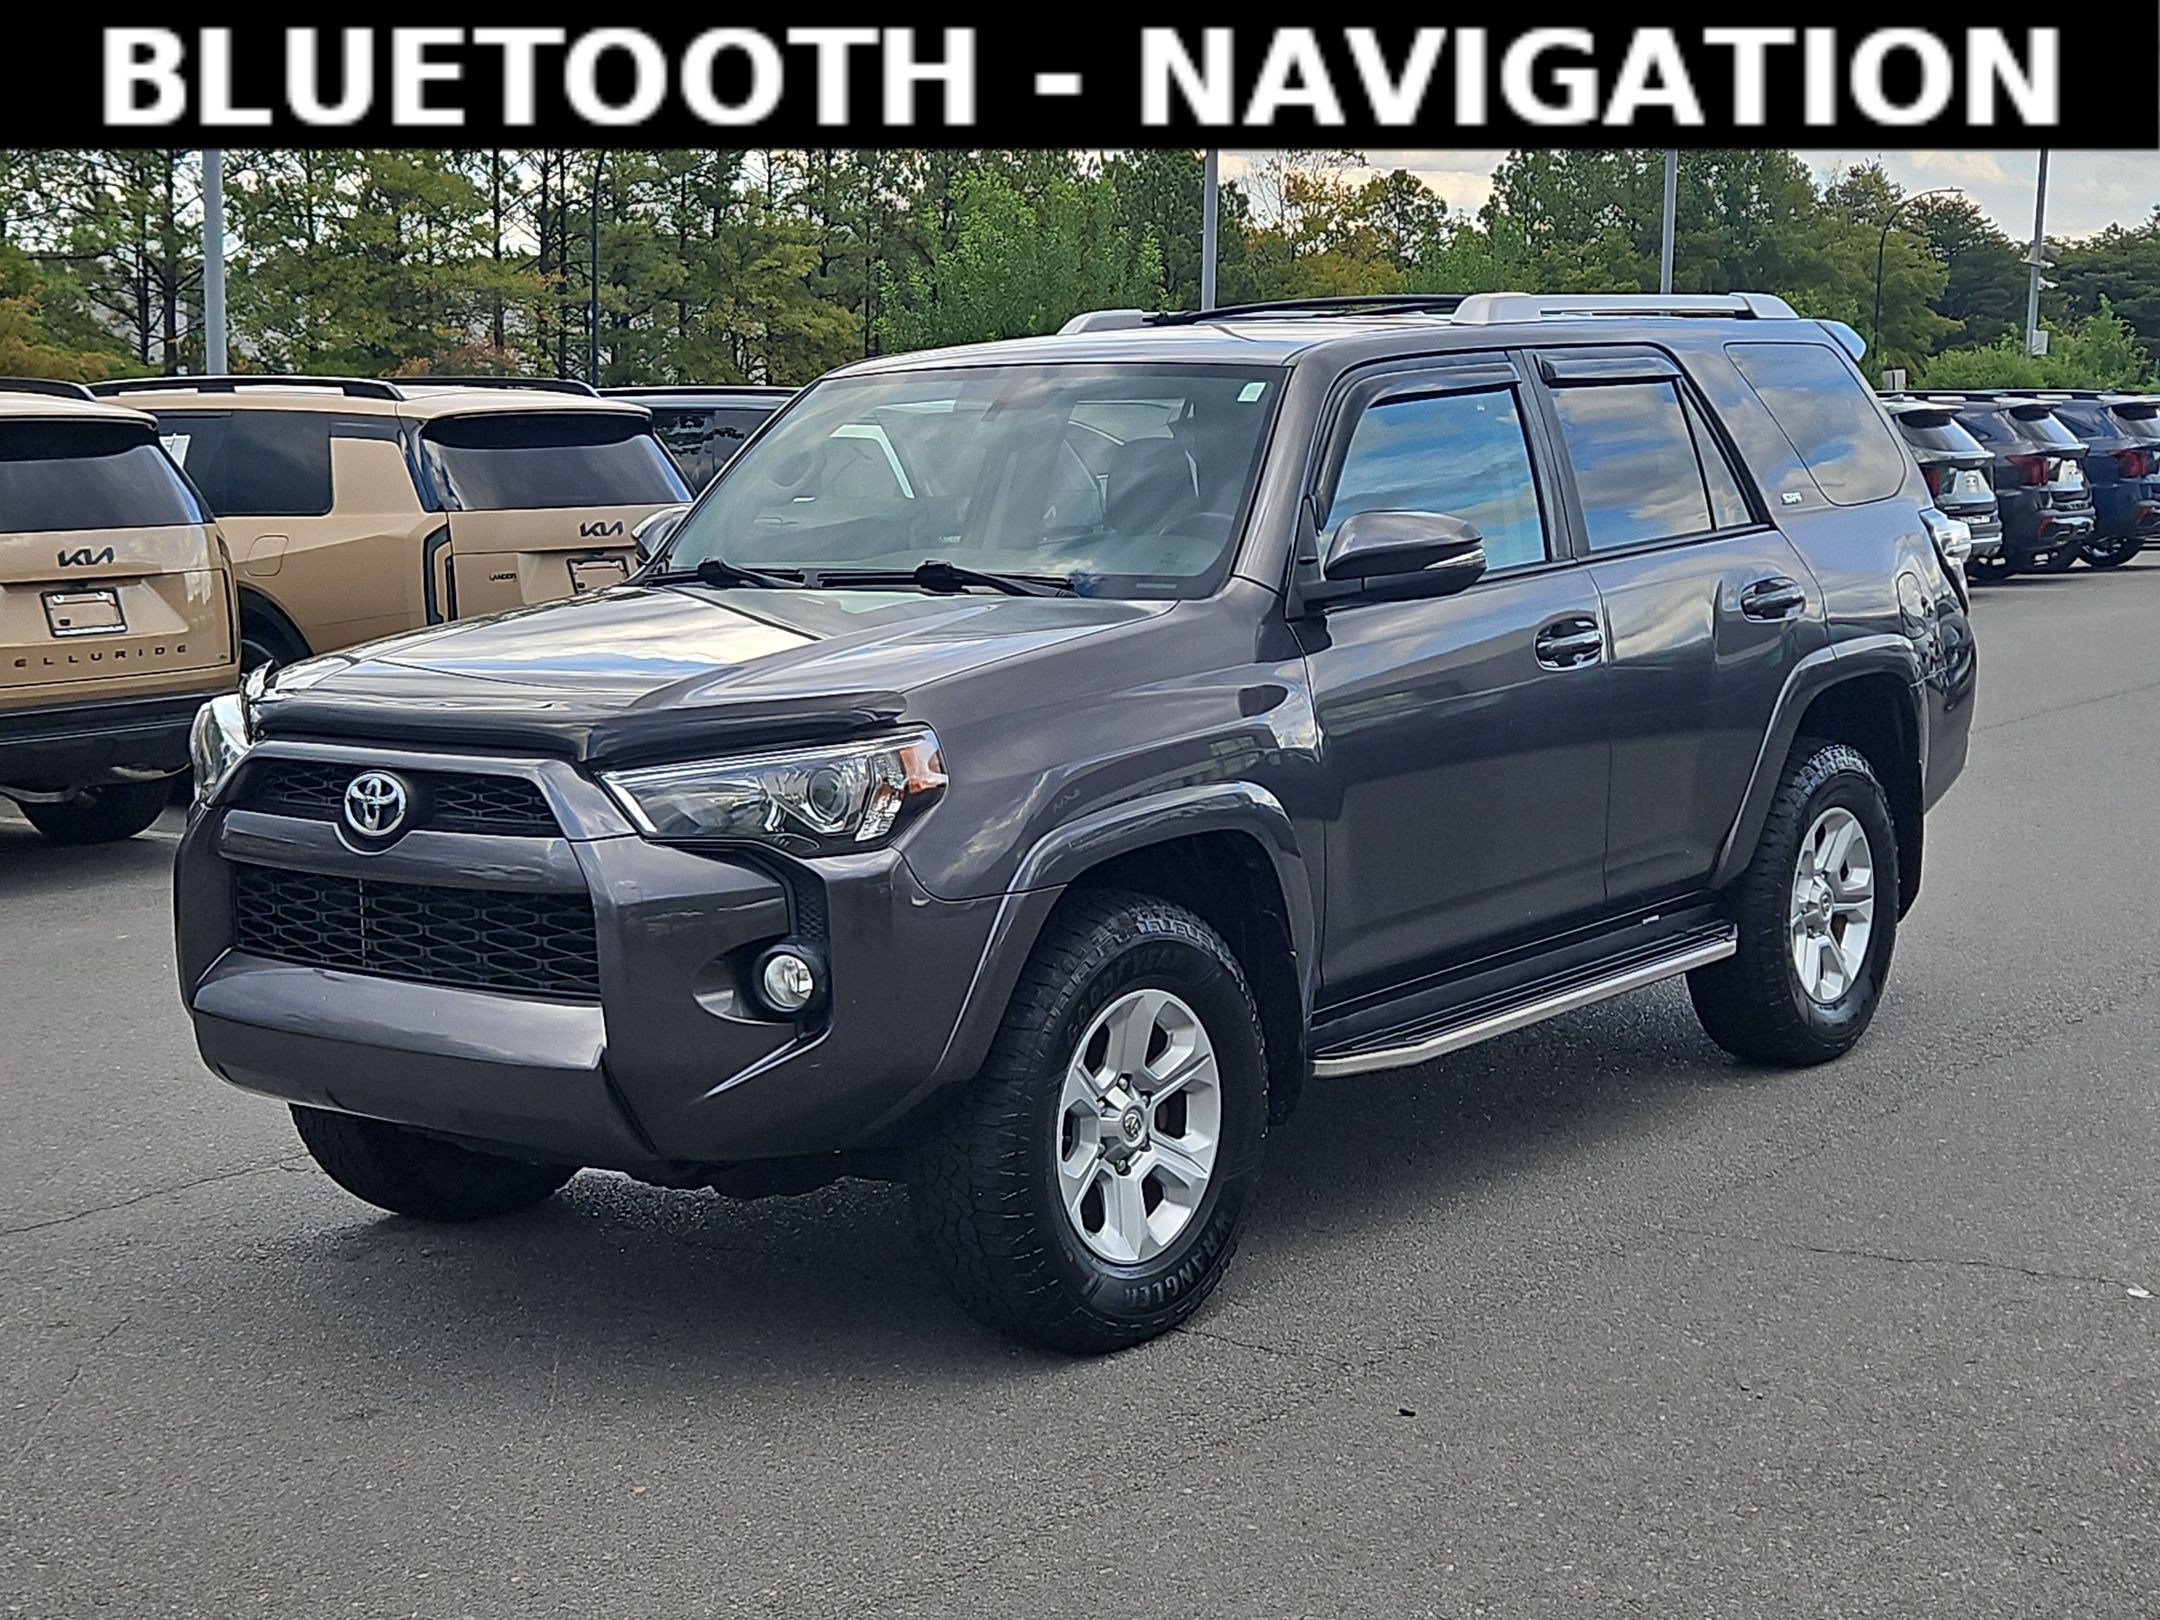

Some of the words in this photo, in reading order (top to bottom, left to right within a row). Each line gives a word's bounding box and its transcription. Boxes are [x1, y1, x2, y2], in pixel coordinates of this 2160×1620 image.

[579, 521, 624, 537] KIA
[57, 547, 115, 567] KIA
[14, 644, 187, 668] ELLURIDE
